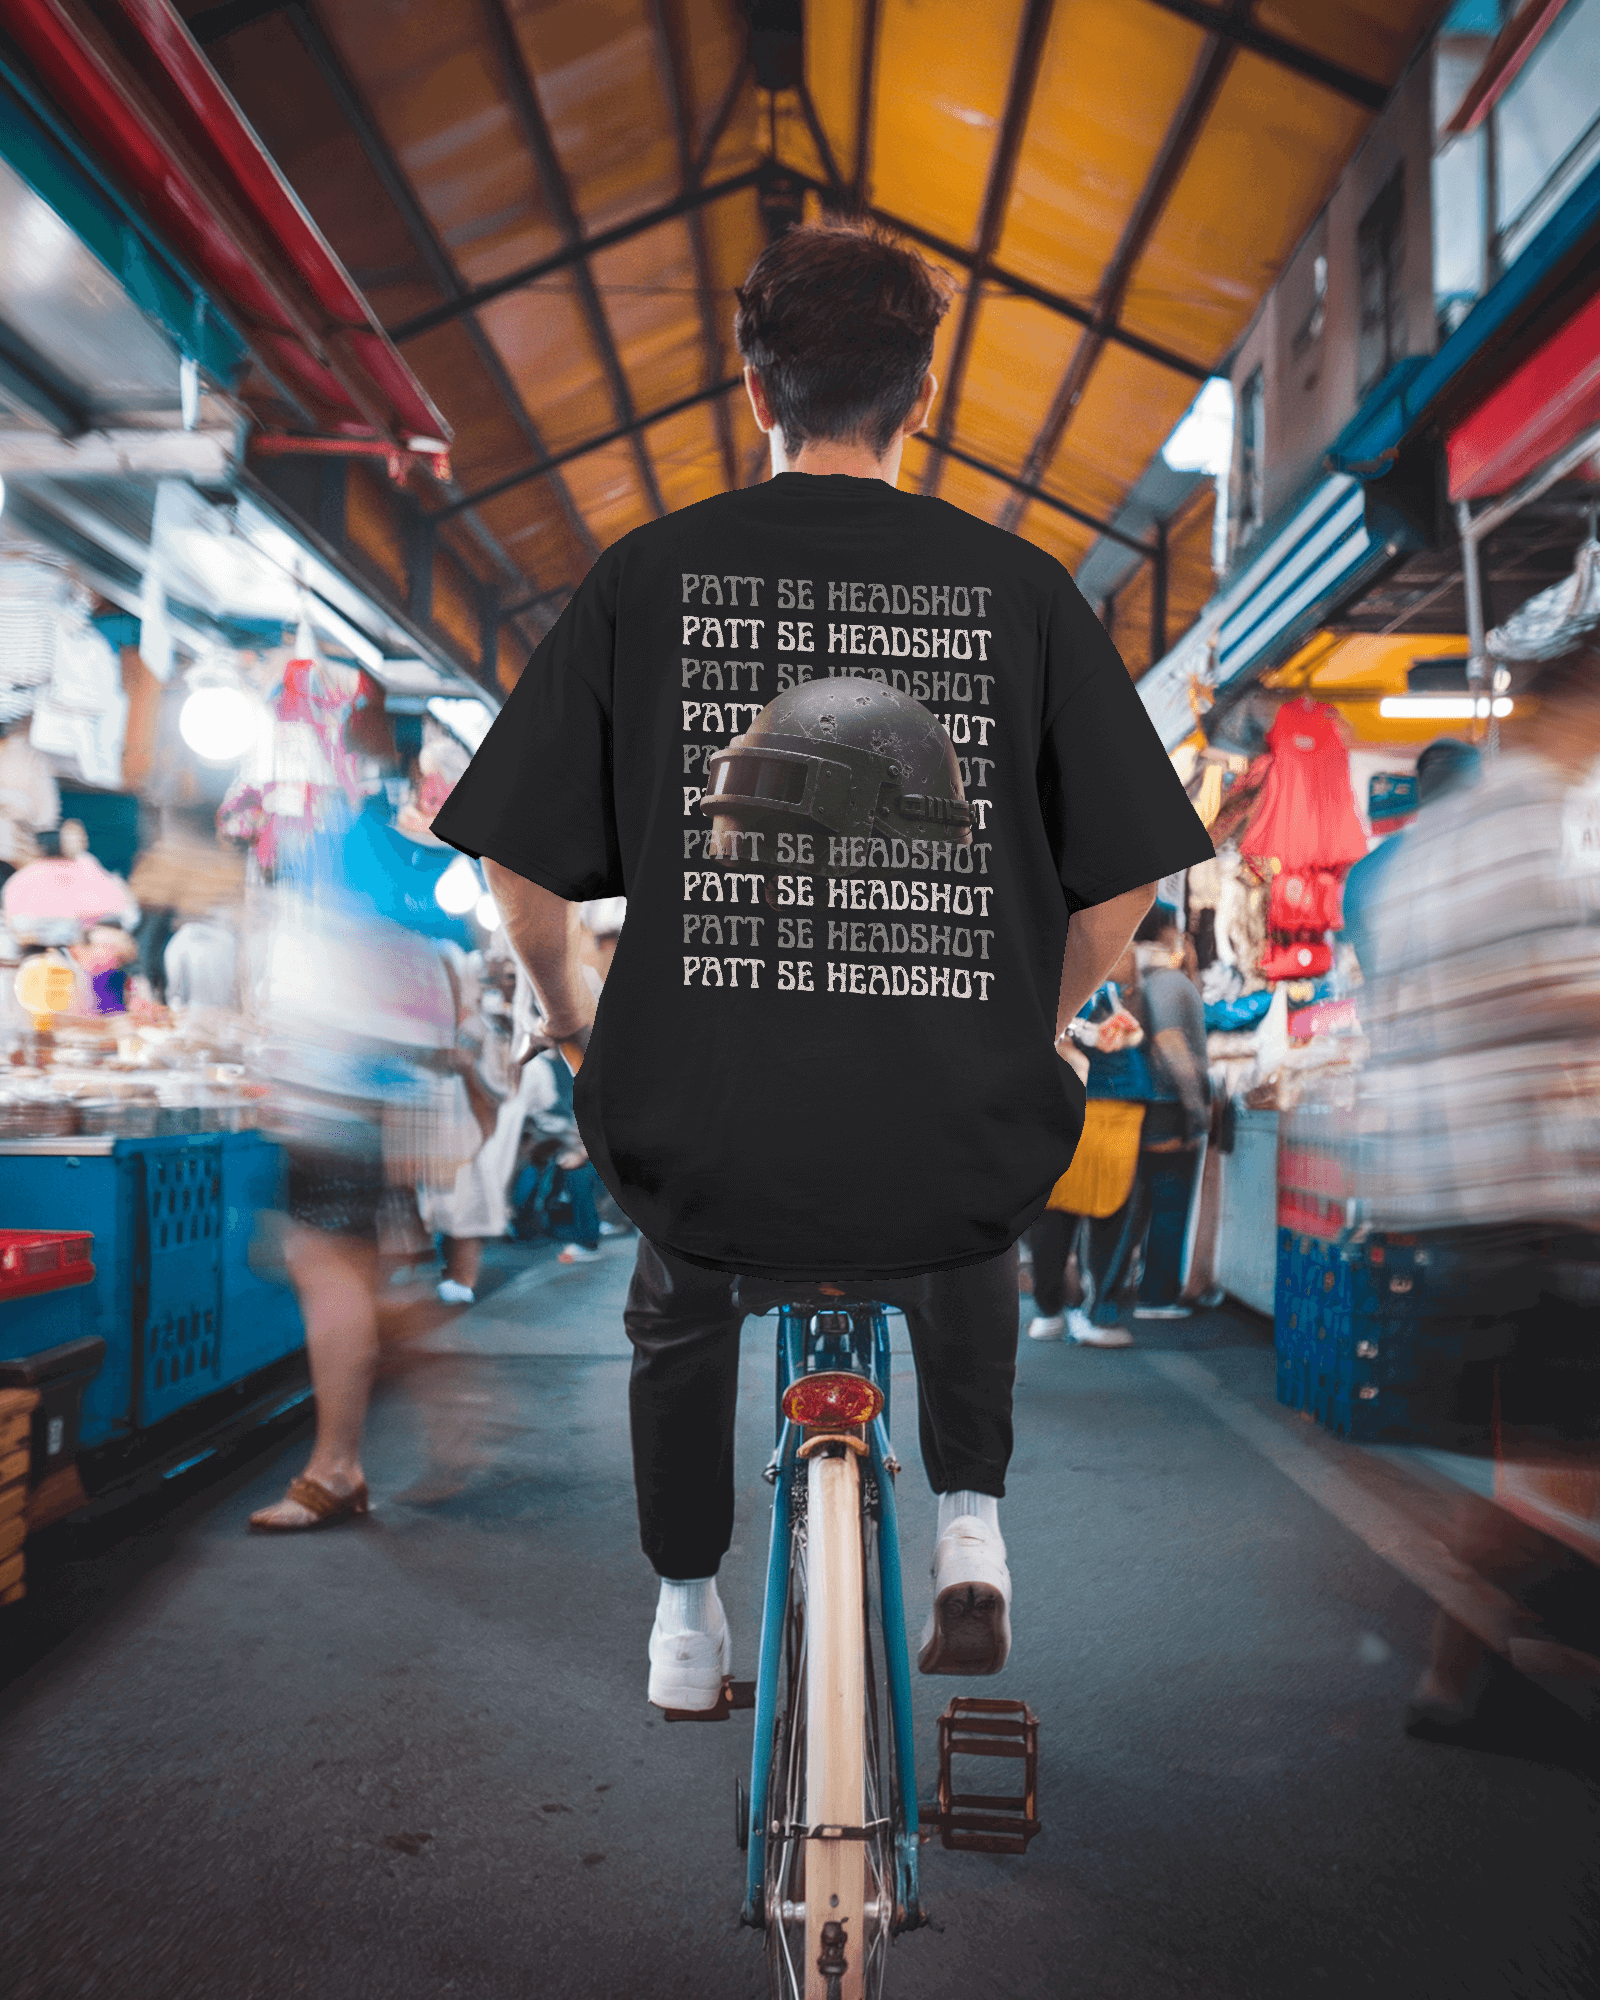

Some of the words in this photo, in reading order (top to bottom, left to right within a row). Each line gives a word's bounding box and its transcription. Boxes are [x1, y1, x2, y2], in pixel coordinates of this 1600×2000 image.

[682, 574, 764, 606] PATT
[778, 579, 814, 611] SE
[828, 582, 992, 618] HEADSHOT
[683, 616, 764, 649] PATT
[778, 621, 814, 653] SE
[828, 623, 992, 661] HEADSHOT
[681, 658, 764, 691] PATT
[777, 664, 813, 693] SE
[684, 830, 764, 863] PATT
[777, 833, 814, 864] SE
[828, 836, 992, 874] HEADSHOT
[684, 872, 765, 905] PATT
[777, 875, 814, 907] SE
[828, 878, 994, 916] HEADSHOT
[683, 914, 764, 946] PATT
[778, 918, 814, 949] SE
[828, 921, 995, 959] HEADSHOT
[683, 956, 765, 989] PATT
[777, 960, 814, 992] SE
[827, 962, 995, 1001] HEADSHOT
